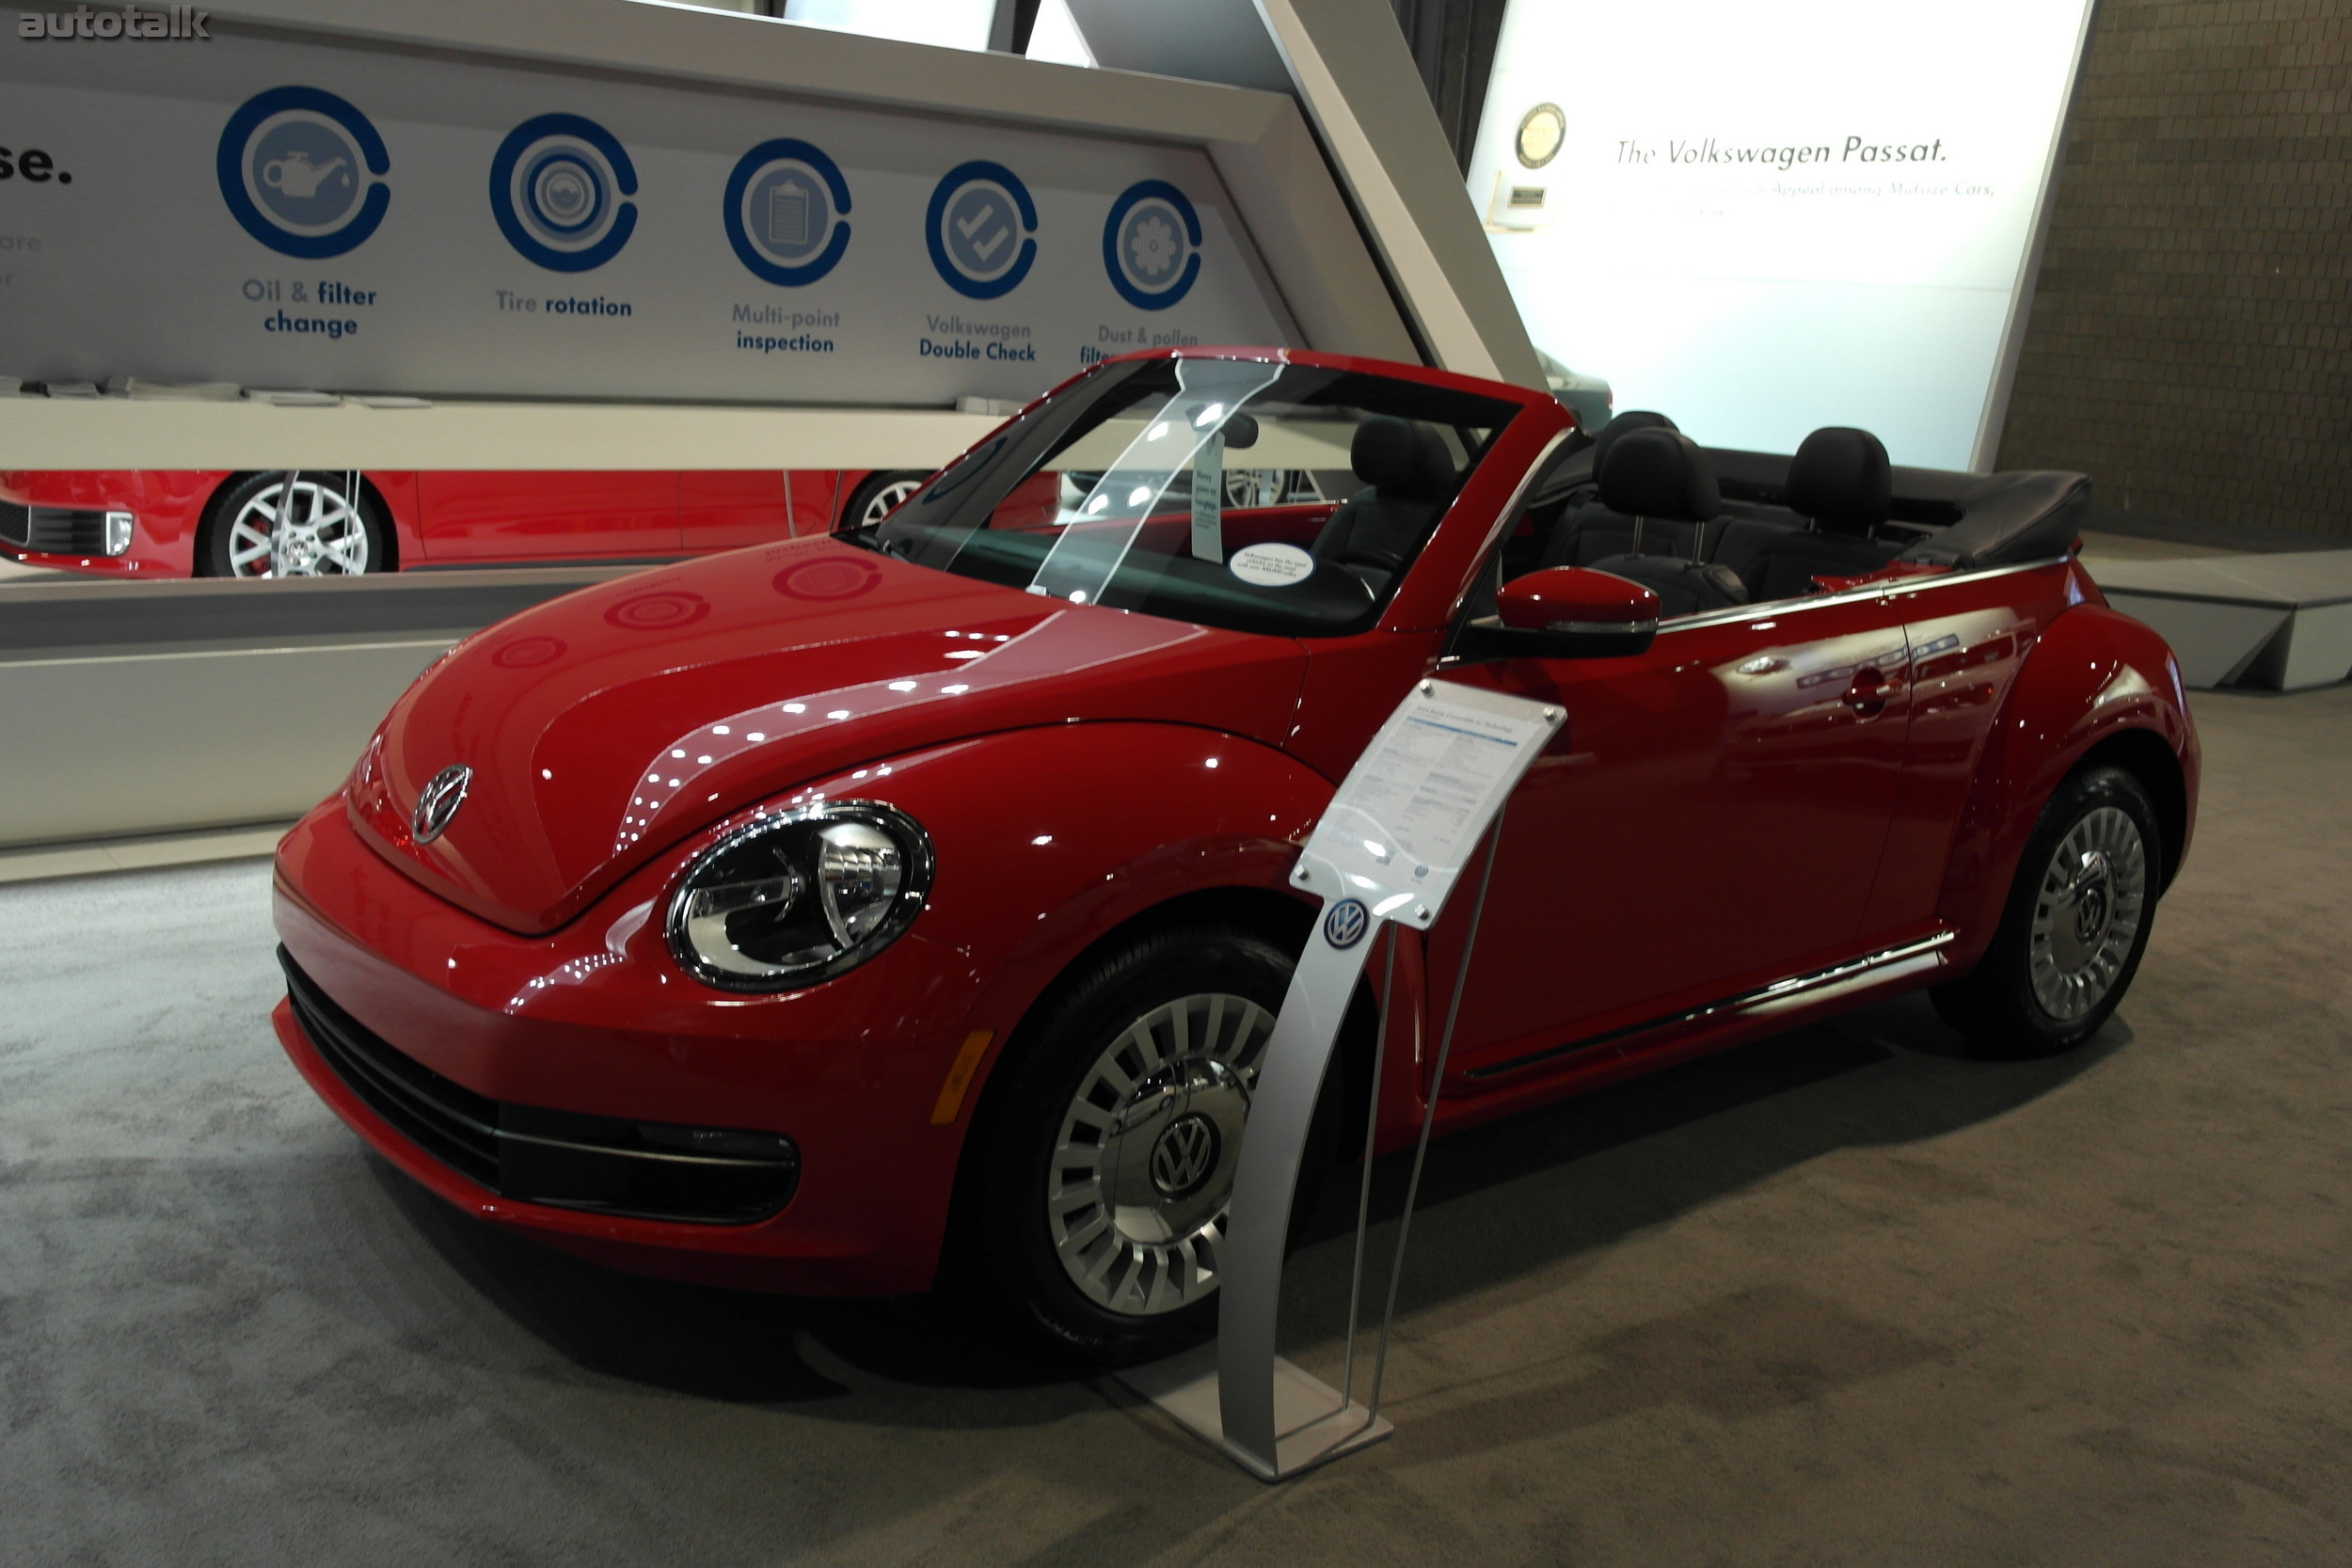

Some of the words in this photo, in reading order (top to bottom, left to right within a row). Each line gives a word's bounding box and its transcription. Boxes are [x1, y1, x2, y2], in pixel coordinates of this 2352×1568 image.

[1617, 139, 1655, 164] The
[1668, 137, 1830, 170] Volkswagen
[1841, 135, 1947, 162] Passat.
[242, 278, 281, 301] Oil
[291, 280, 309, 303] &
[318, 280, 376, 305] filter
[495, 290, 537, 311] Tire
[546, 296, 632, 316] rotation
[263, 309, 358, 339] change
[732, 303, 840, 330] Multi-point
[927, 314, 1031, 340] Volkswagen
[737, 329, 834, 355] inspection
[1099, 325, 1133, 343] Dust
[1136, 326, 1147, 344] &
[1152, 329, 1198, 347] pollen
[919, 338, 980, 359] Double
[986, 341, 1036, 361] Check
[1080, 345, 1115, 363] filte
